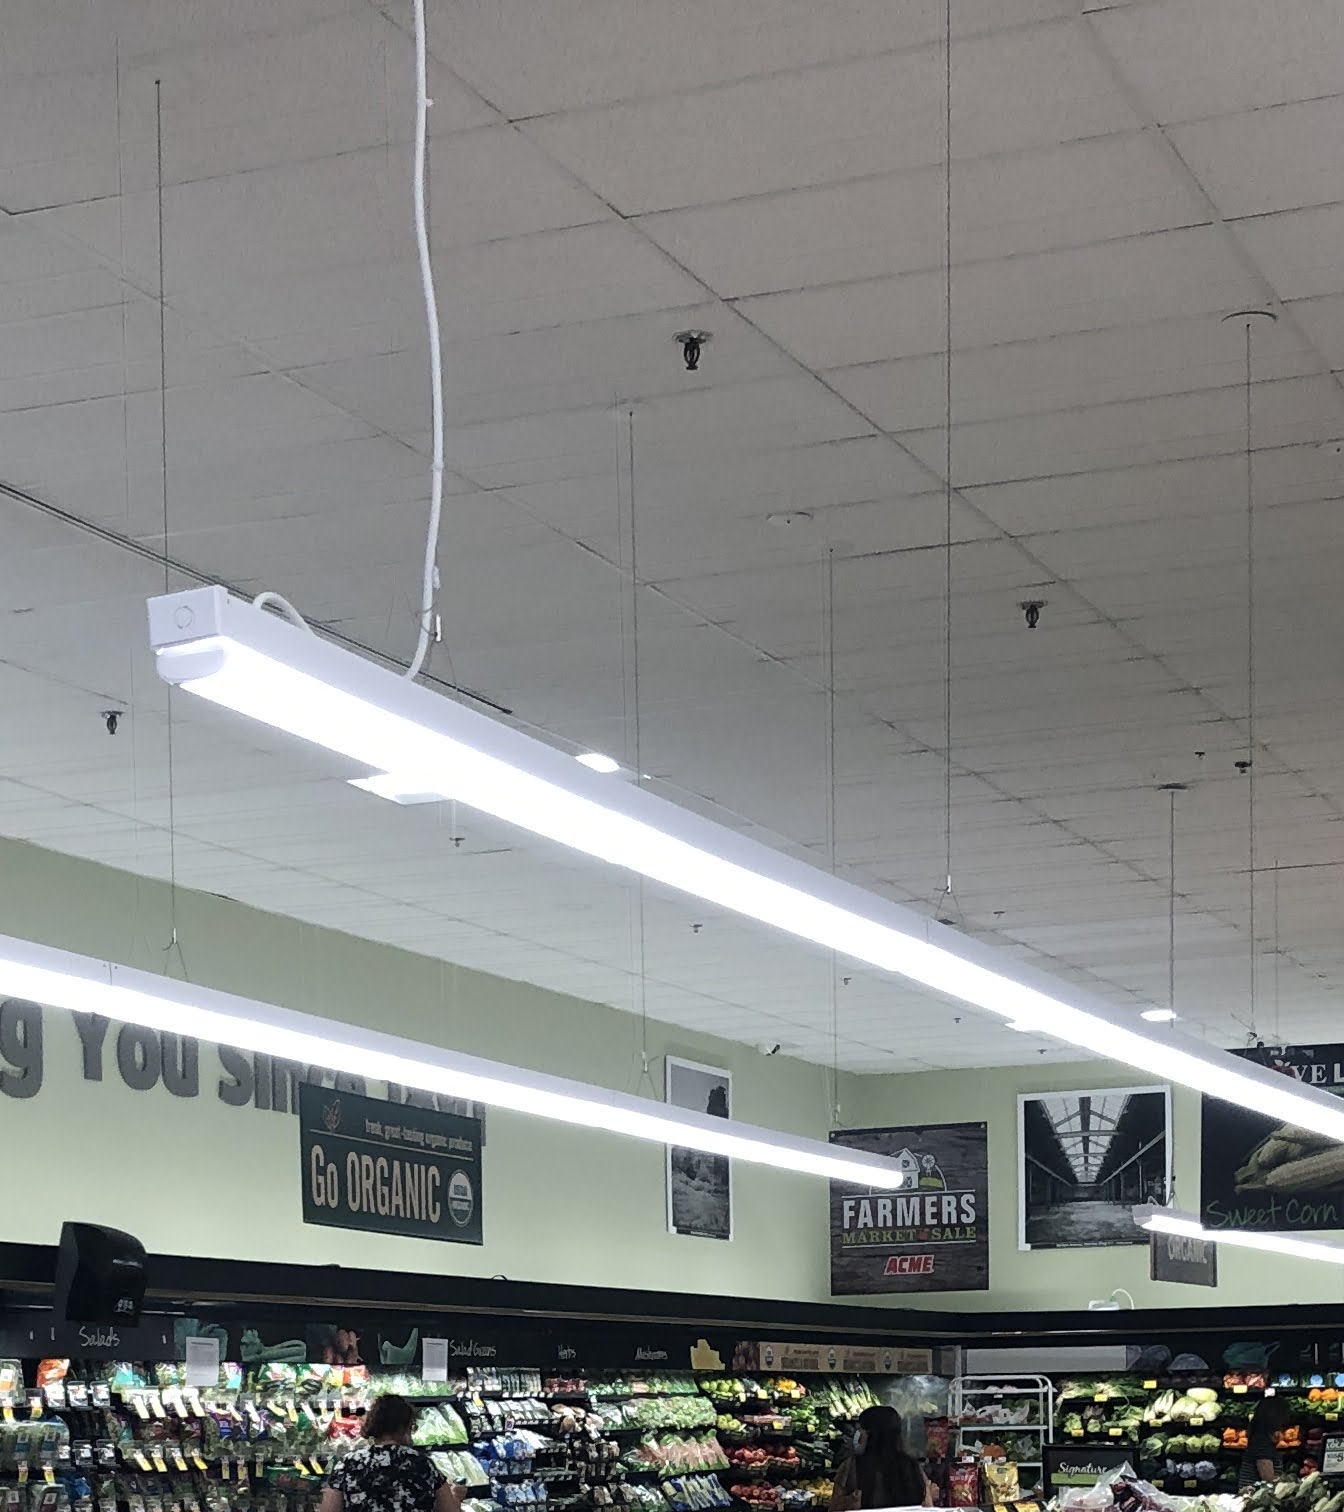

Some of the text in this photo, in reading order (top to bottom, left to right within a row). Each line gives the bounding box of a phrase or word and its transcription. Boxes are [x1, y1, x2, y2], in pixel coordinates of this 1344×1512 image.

[73, 1009, 200, 1098] You
[311, 1145, 441, 1223] Go ORGANIC
[842, 1194, 976, 1229] FARMERS
[1207, 1196, 1282, 1228] Sweet
[1286, 1198, 1337, 1224] Corn
[842, 1227, 976, 1244] MARKET SALE
[884, 1255, 934, 1275] ACME
[79, 1325, 120, 1347] Salads
